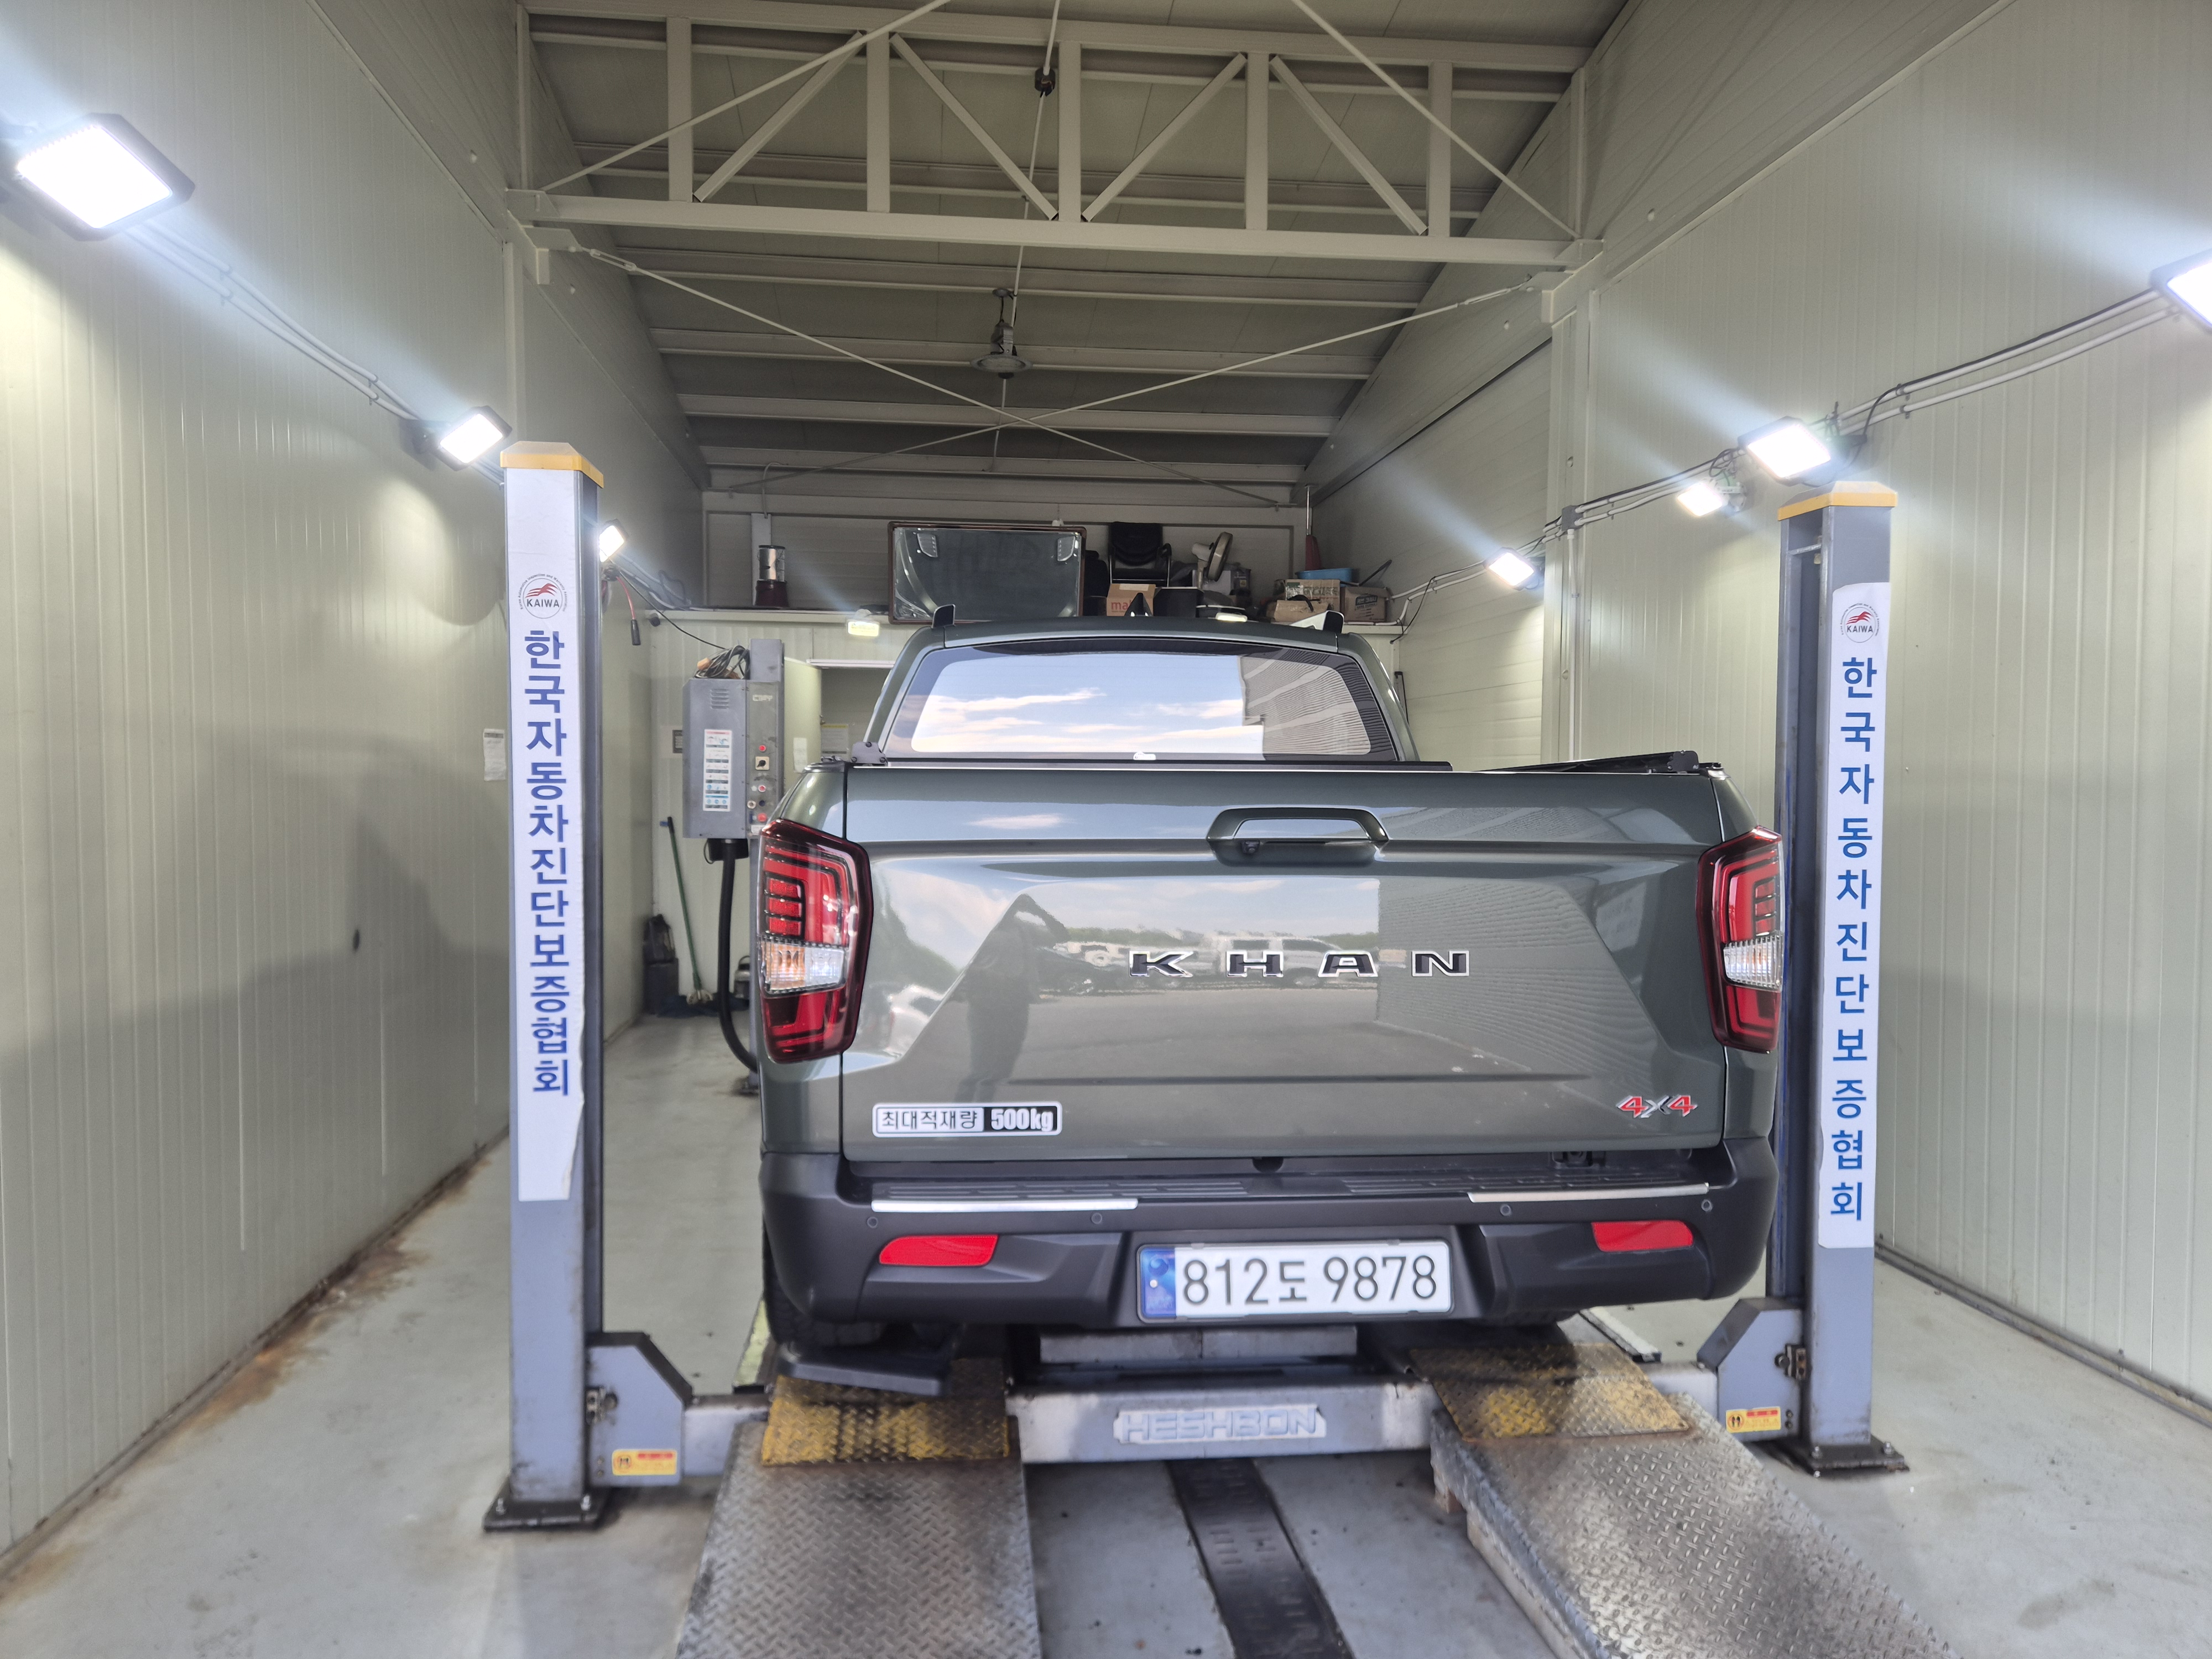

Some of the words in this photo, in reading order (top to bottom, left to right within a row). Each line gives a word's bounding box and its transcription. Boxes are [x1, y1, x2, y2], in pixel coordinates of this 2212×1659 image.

[526, 599, 560, 608] KAIWA
[1111, 599, 1131, 610] ma
[524, 630, 570, 1096] 한국자동차진단보증협회
[1830, 656, 1877, 1221] 한국자동차진단보증협회
[1129, 950, 1469, 978] KHAN
[881, 1110, 978, 1130] 최대적재량
[990, 1108, 1054, 1132] 500kg
[1122, 1408, 1317, 1441] HESHBON
